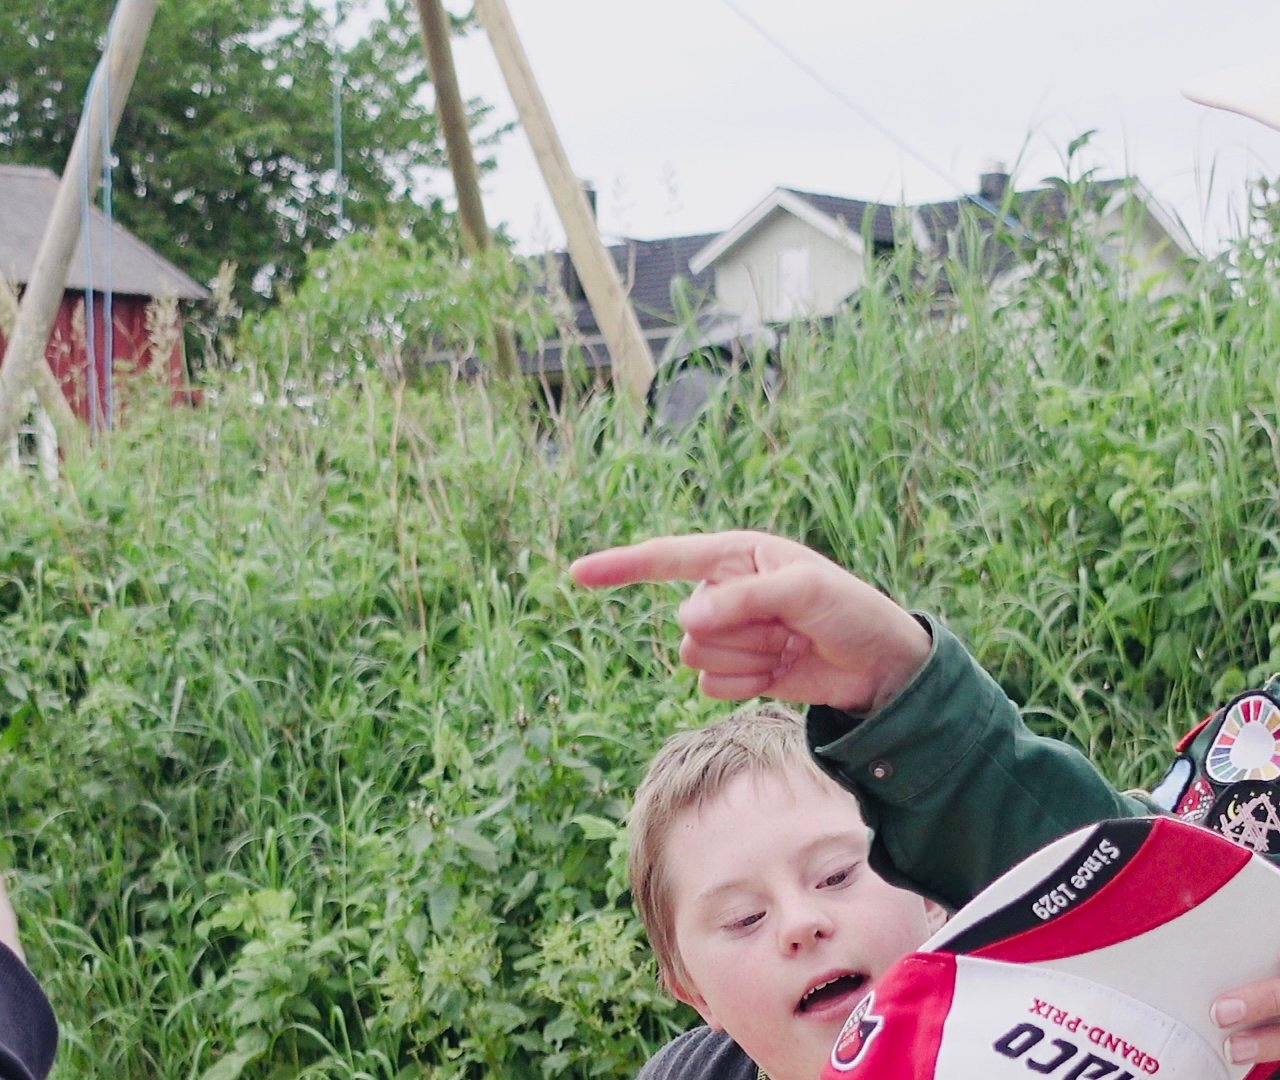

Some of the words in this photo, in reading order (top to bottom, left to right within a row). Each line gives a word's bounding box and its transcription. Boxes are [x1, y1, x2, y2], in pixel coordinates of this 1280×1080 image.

[1070, 839, 1120, 889] Since
[1032, 882, 1077, 920] 1929
[1029, 998, 1160, 1076] GRAND-PRIX
